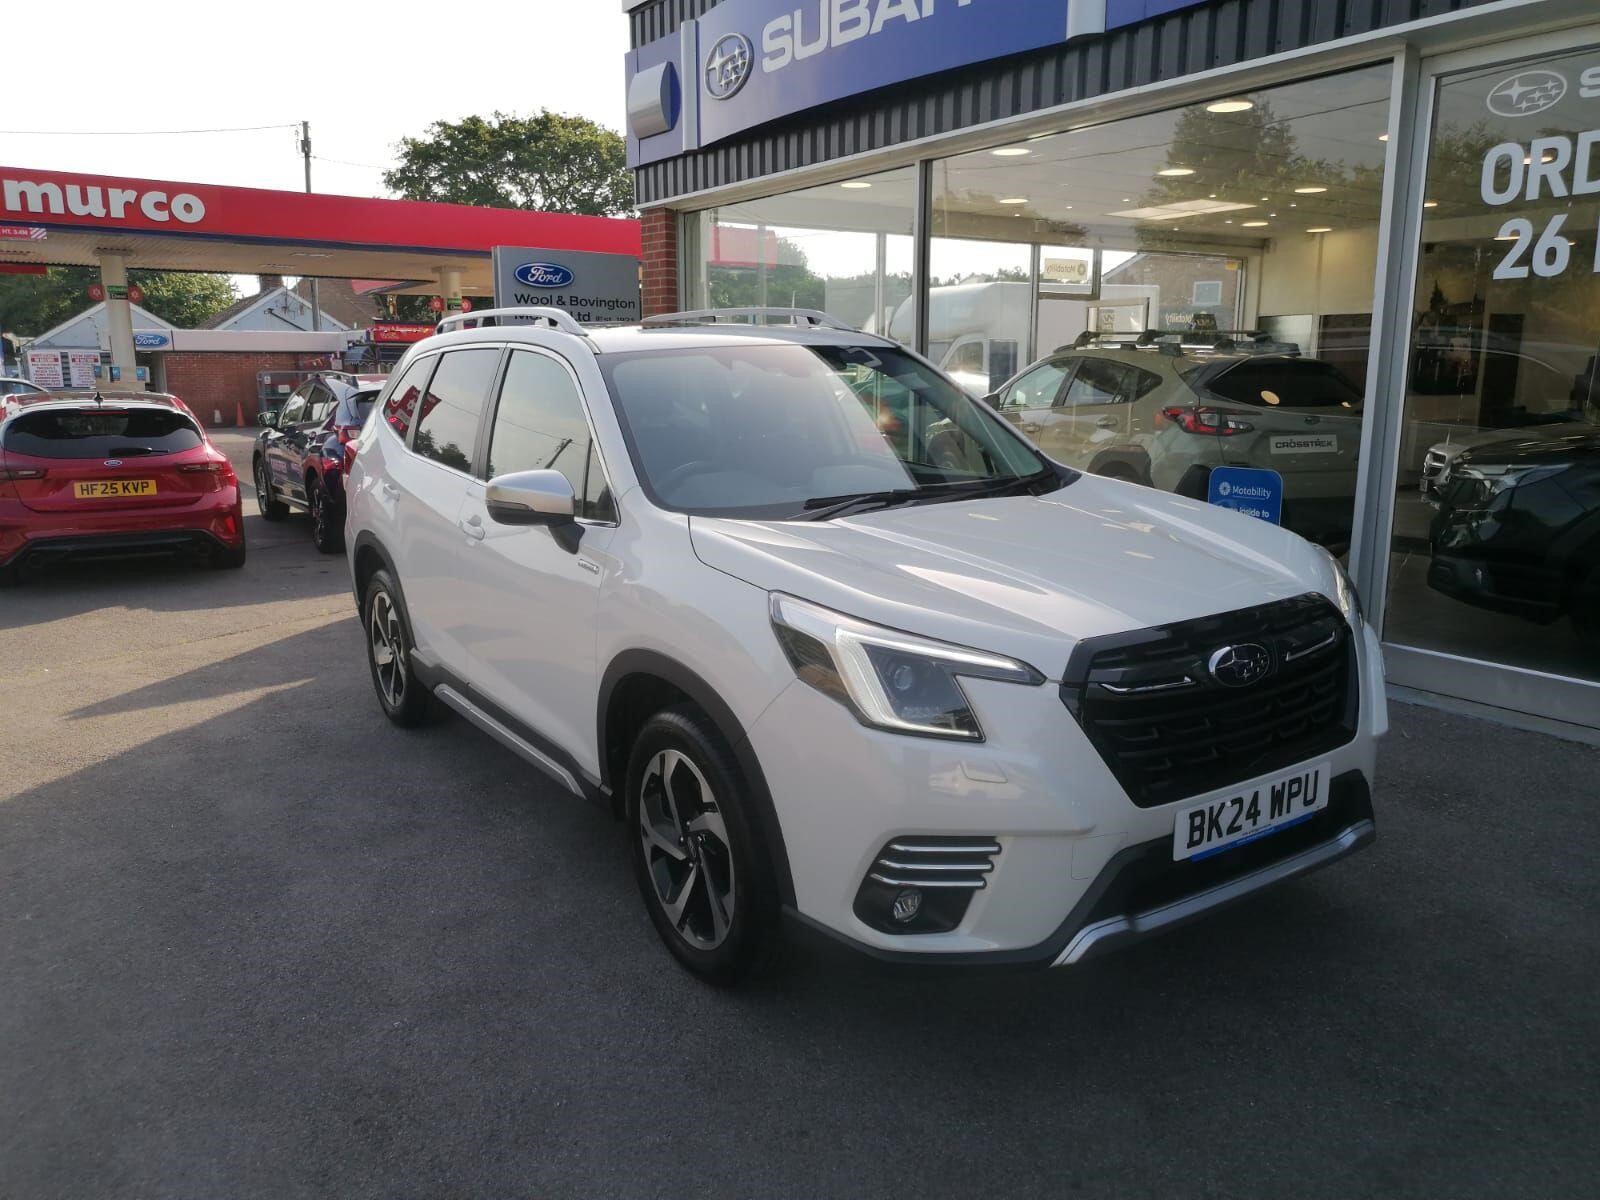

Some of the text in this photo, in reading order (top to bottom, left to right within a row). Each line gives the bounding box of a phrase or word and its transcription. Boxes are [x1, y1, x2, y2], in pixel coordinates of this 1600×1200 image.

[3, 180, 206, 224] murco
[1493, 214, 1570, 280] 26
[527, 265, 563, 283] Ford
[514, 293, 636, 311] Wool & Bovington
[80, 481, 150, 496] HF25 KVP
[1232, 485, 1272, 500] Motability
[1261, 509, 1270, 518] to
[1186, 769, 1320, 849] BK24 WPU
